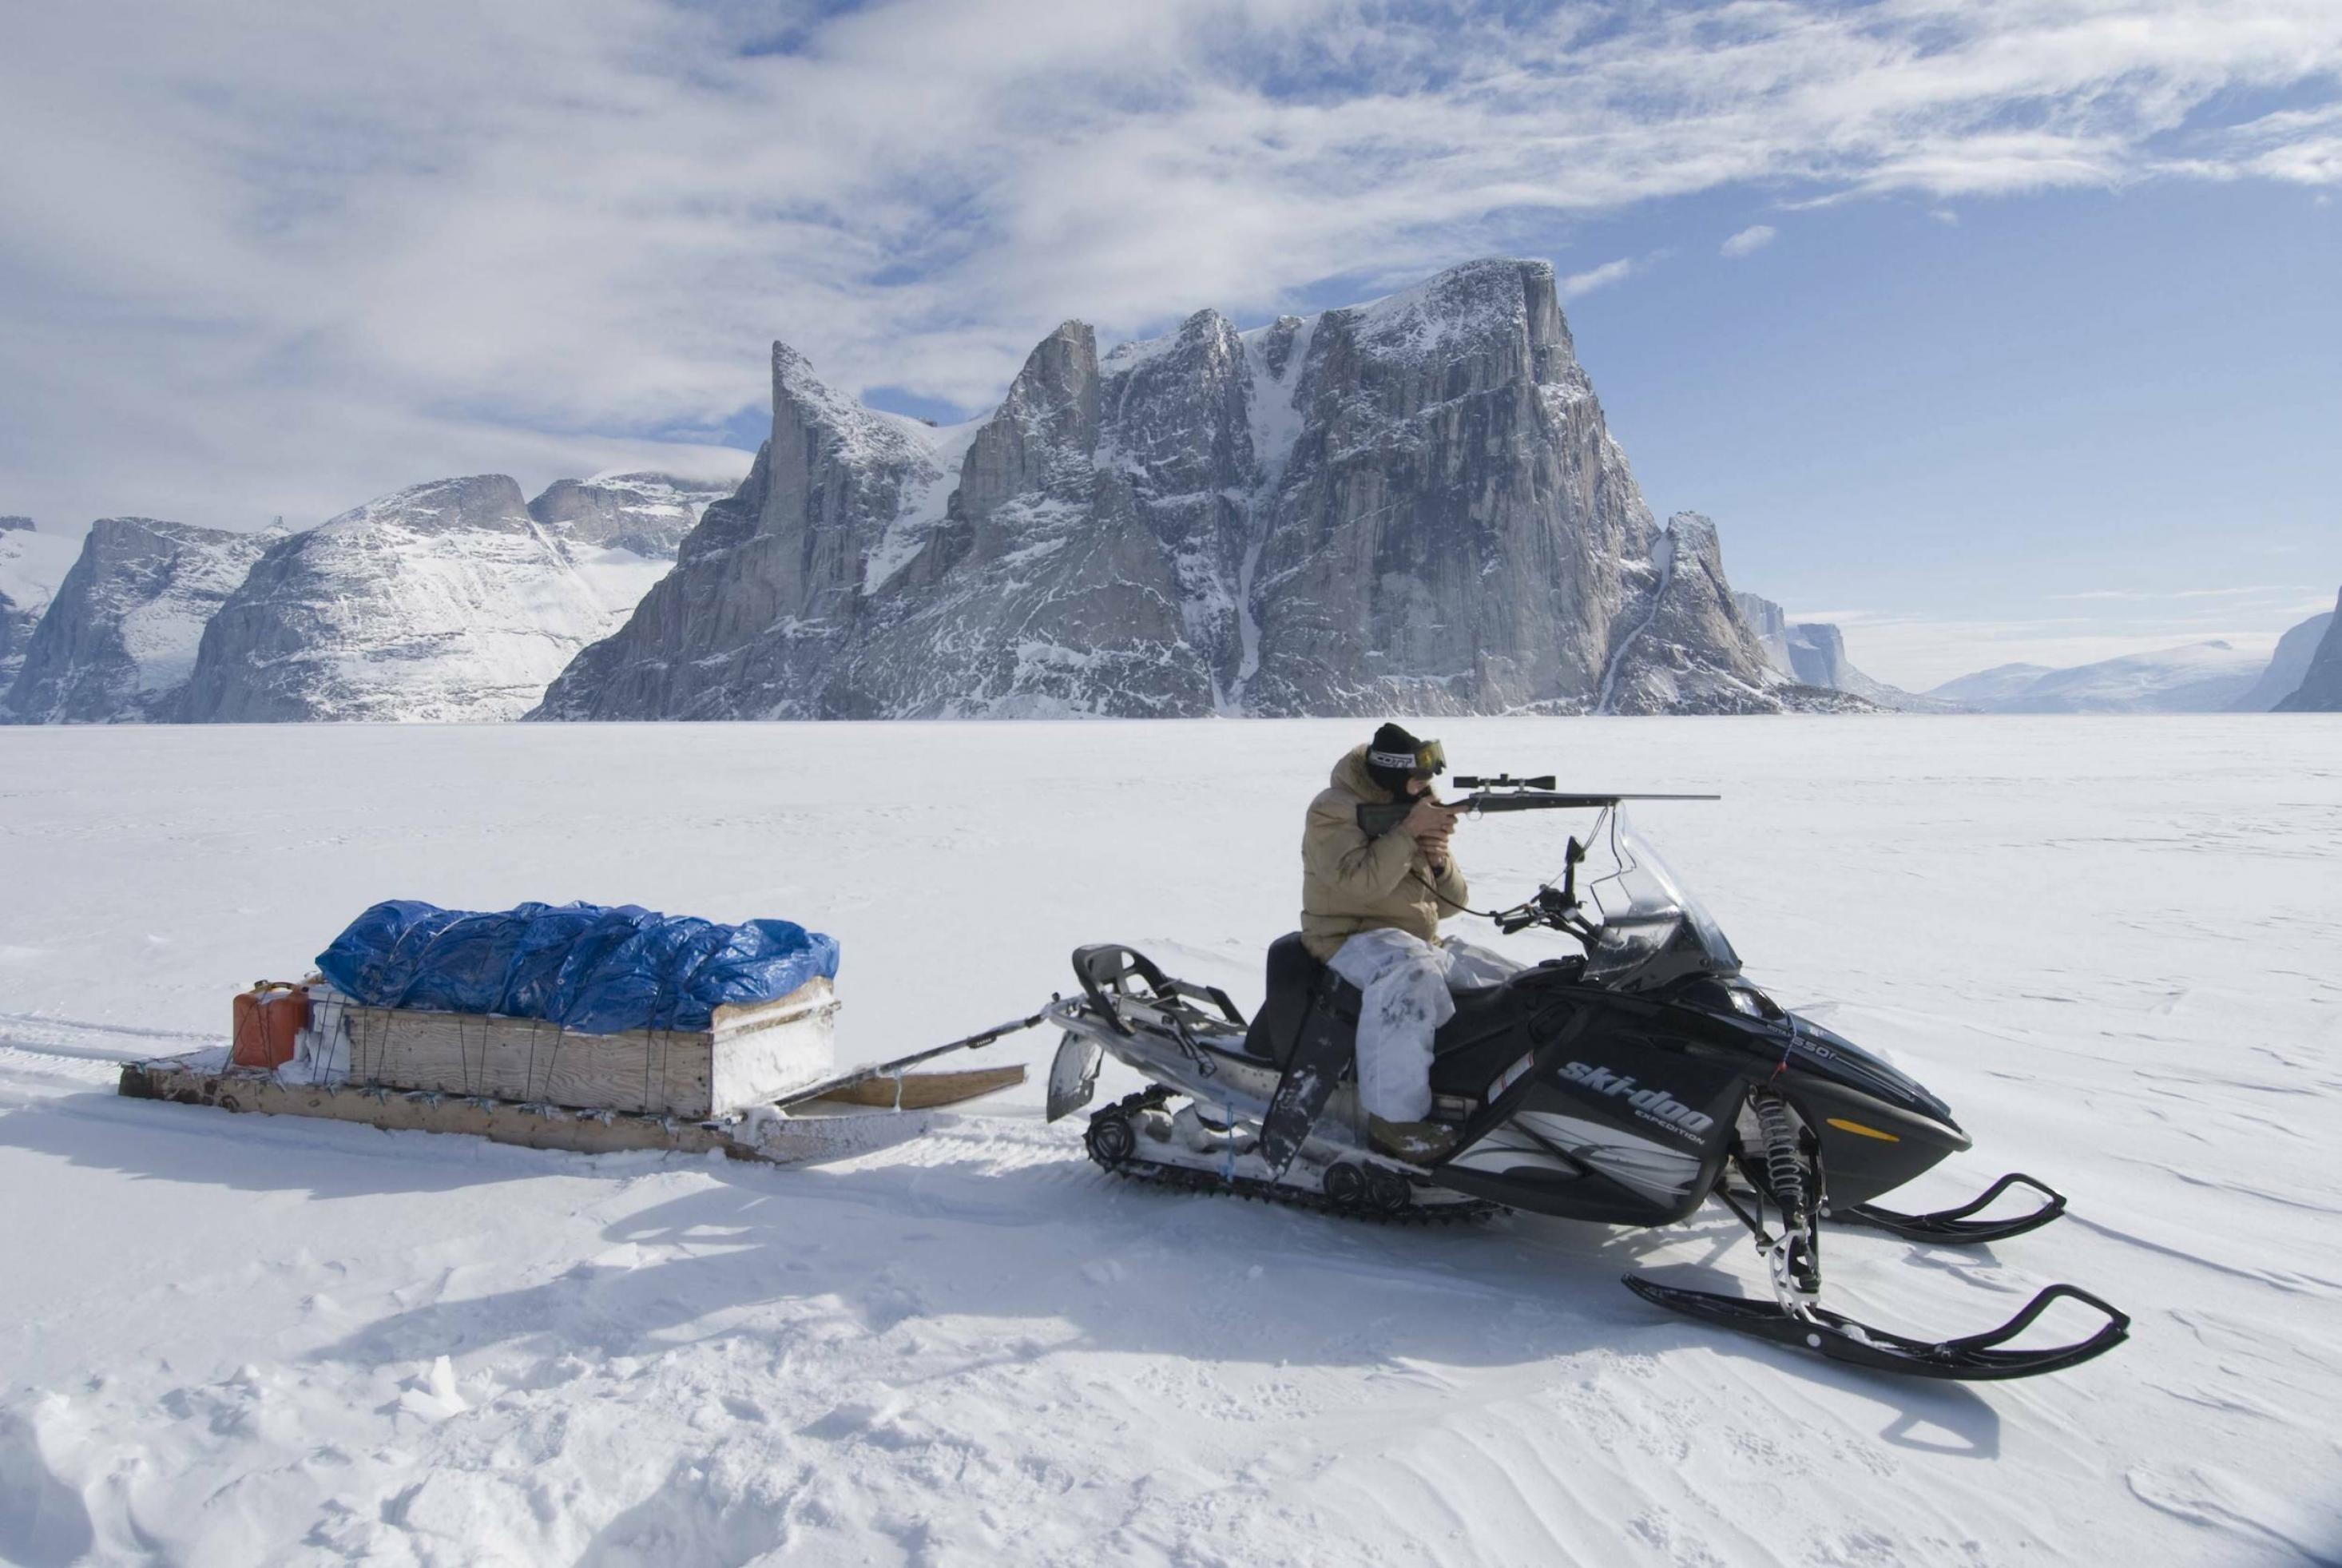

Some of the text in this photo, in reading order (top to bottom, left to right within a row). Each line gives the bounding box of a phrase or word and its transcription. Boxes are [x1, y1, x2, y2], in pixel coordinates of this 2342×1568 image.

[1373, 752, 1412, 768] COTT
[1558, 1062, 1713, 1133] ski-doo
[1634, 1110, 1705, 1145] EXPEDITION
